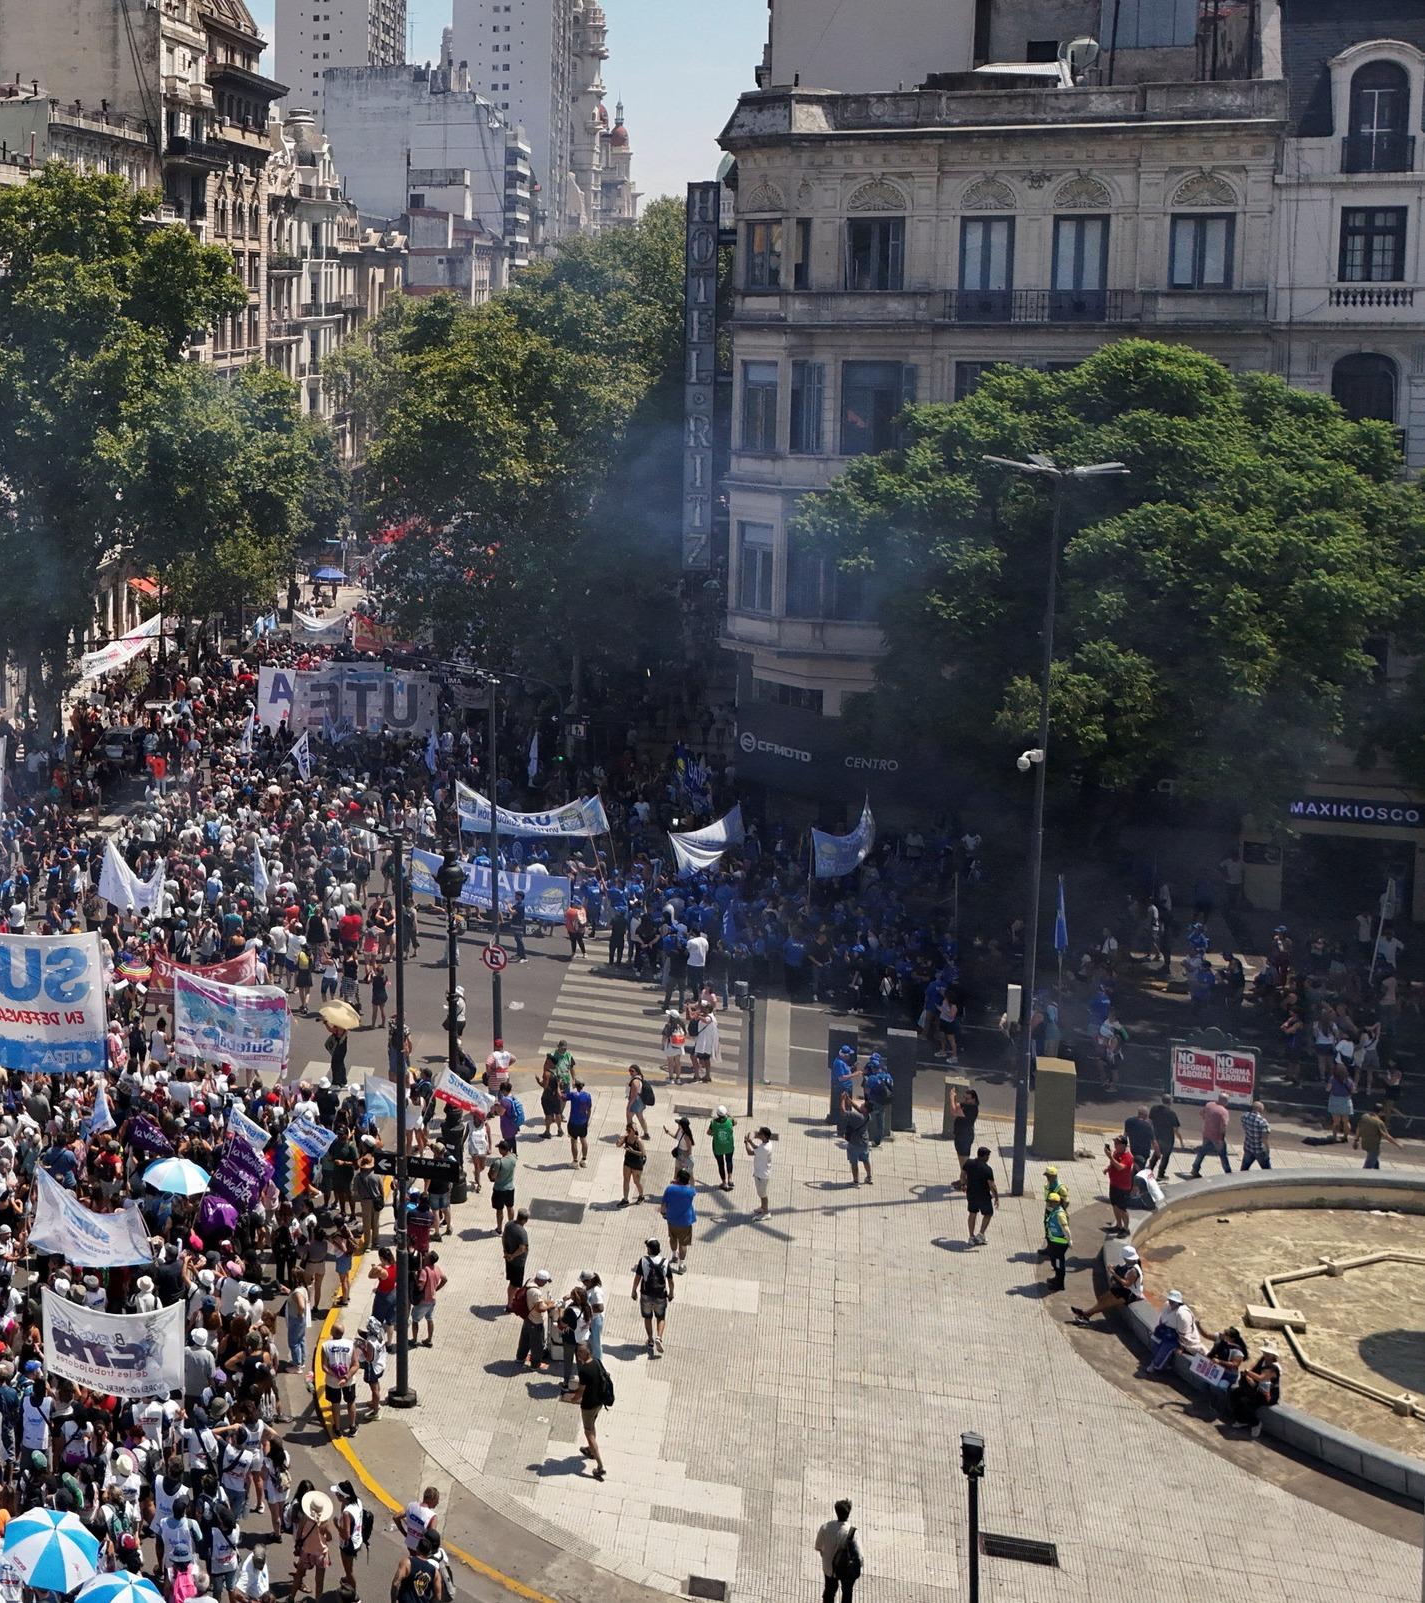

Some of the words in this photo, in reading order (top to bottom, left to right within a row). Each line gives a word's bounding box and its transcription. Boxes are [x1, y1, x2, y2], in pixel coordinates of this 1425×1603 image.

[688, 187, 715, 385] HOTEL
[686, 414, 711, 566] RITZ
[756, 740, 812, 763] CFMOTO
[845, 756, 899, 772] CENTRO
[1290, 802, 1419, 822] MAXIKIOSCO
[1178, 1052, 1194, 1064] NO
[1216, 1056, 1234, 1067] NO
[1178, 1063, 1212, 1073] REFORMA
[1216, 1067, 1251, 1076] REFORMA
[1178, 1070, 1212, 1080] LABORAL
[1216, 1073, 1251, 1083] LABORAL
